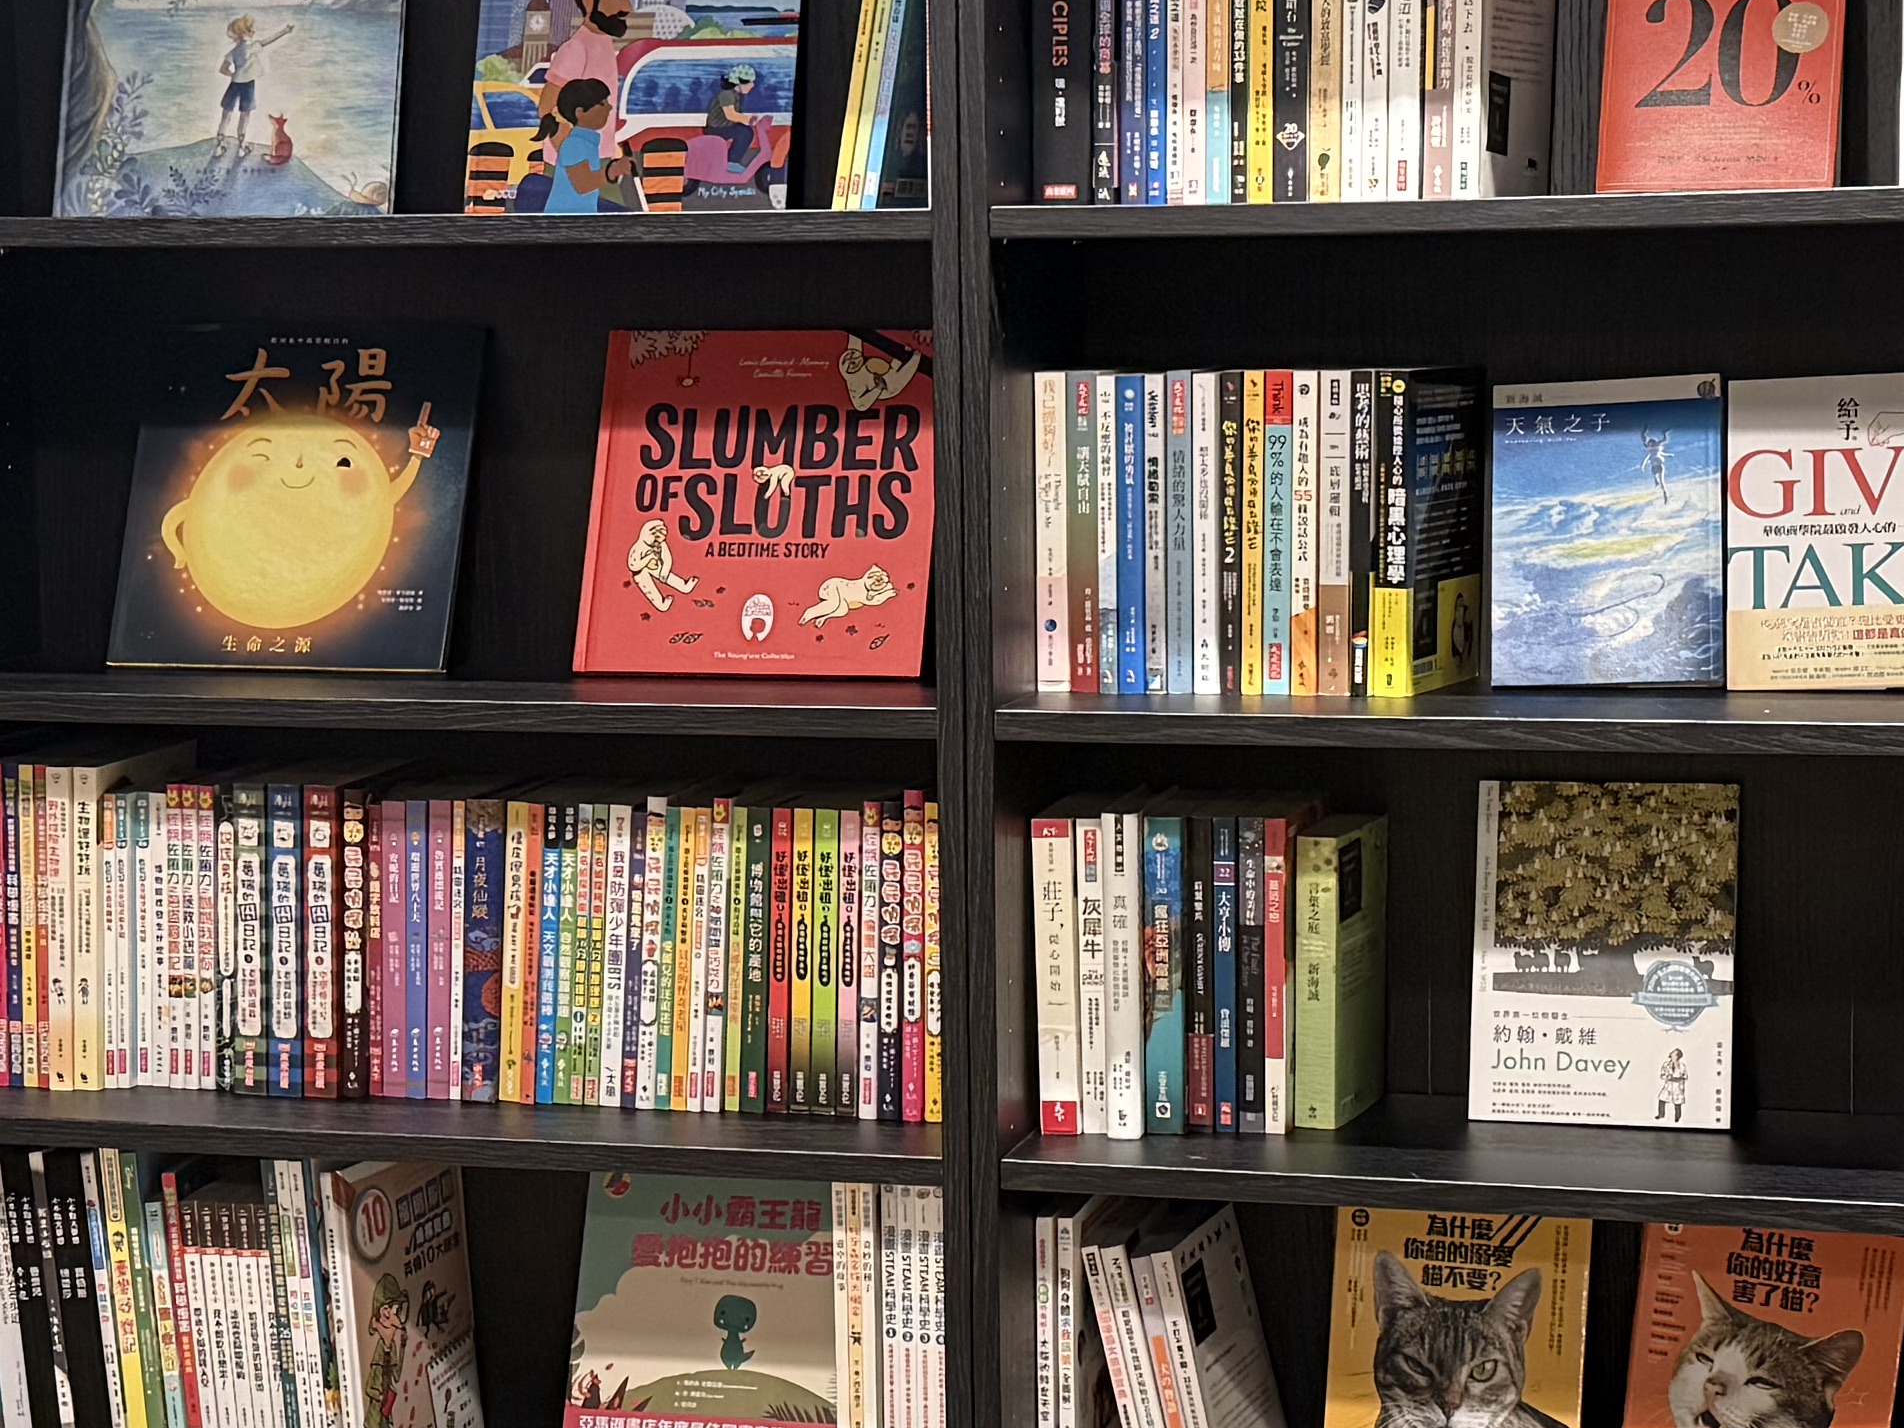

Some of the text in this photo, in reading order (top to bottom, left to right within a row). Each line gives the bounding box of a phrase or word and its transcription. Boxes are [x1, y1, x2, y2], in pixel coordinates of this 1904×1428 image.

[220, 348, 392, 423] 太陽
[1271, 381, 1284, 414] Think
[640, 403, 920, 471] SLUMBER
[1505, 414, 1610, 436] 天氣之子
[1076, 445, 1090, 515] 讓天賦自由
[635, 471, 911, 540] OF SLOTHS
[1840, 504, 1861, 517] and
[705, 543, 830, 559] A BEDTIME STORY
[1386, 489, 1406, 584] 暗黑心理學
[221, 636, 313, 653] 生命之源
[472, 856, 488, 920] 月夜仙蹤
[1082, 896, 1103, 960] 灰犀牛
[1218, 891, 1232, 953] 大亨小傳
[1307, 963, 1320, 1003] 新海誠
[1492, 1048, 1630, 1079] John Davey
[660, 1192, 822, 1232] 小小霸王龍
[1427, 1214, 1494, 1240] 為什麼
[1404, 1239, 1514, 1268] 你給的溺愛
[1741, 1228, 1815, 1262] 為什麼
[1421, 1266, 1502, 1291] 貓不要？
[1727, 1253, 1822, 1290] 你的好意
[1732, 1280, 1819, 1314] 害了貓？
